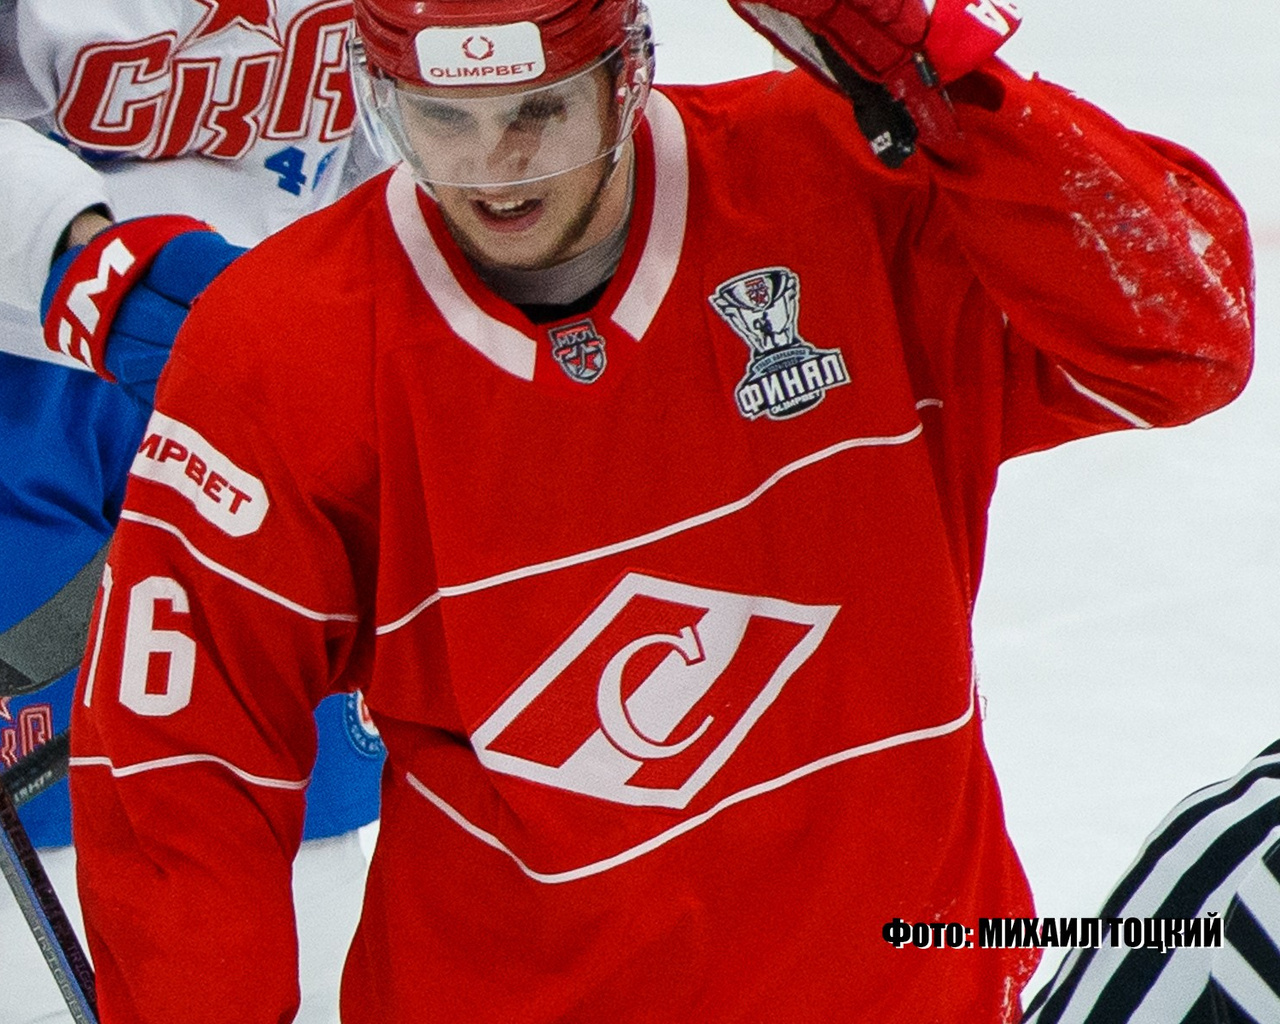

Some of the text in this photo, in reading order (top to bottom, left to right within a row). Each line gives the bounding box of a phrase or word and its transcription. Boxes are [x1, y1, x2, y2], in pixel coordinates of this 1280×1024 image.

[430, 61, 536, 78] OLIMPBET
[740, 354, 845, 414] ФИНАЛ
[771, 391, 821, 414] OLIMPBET
